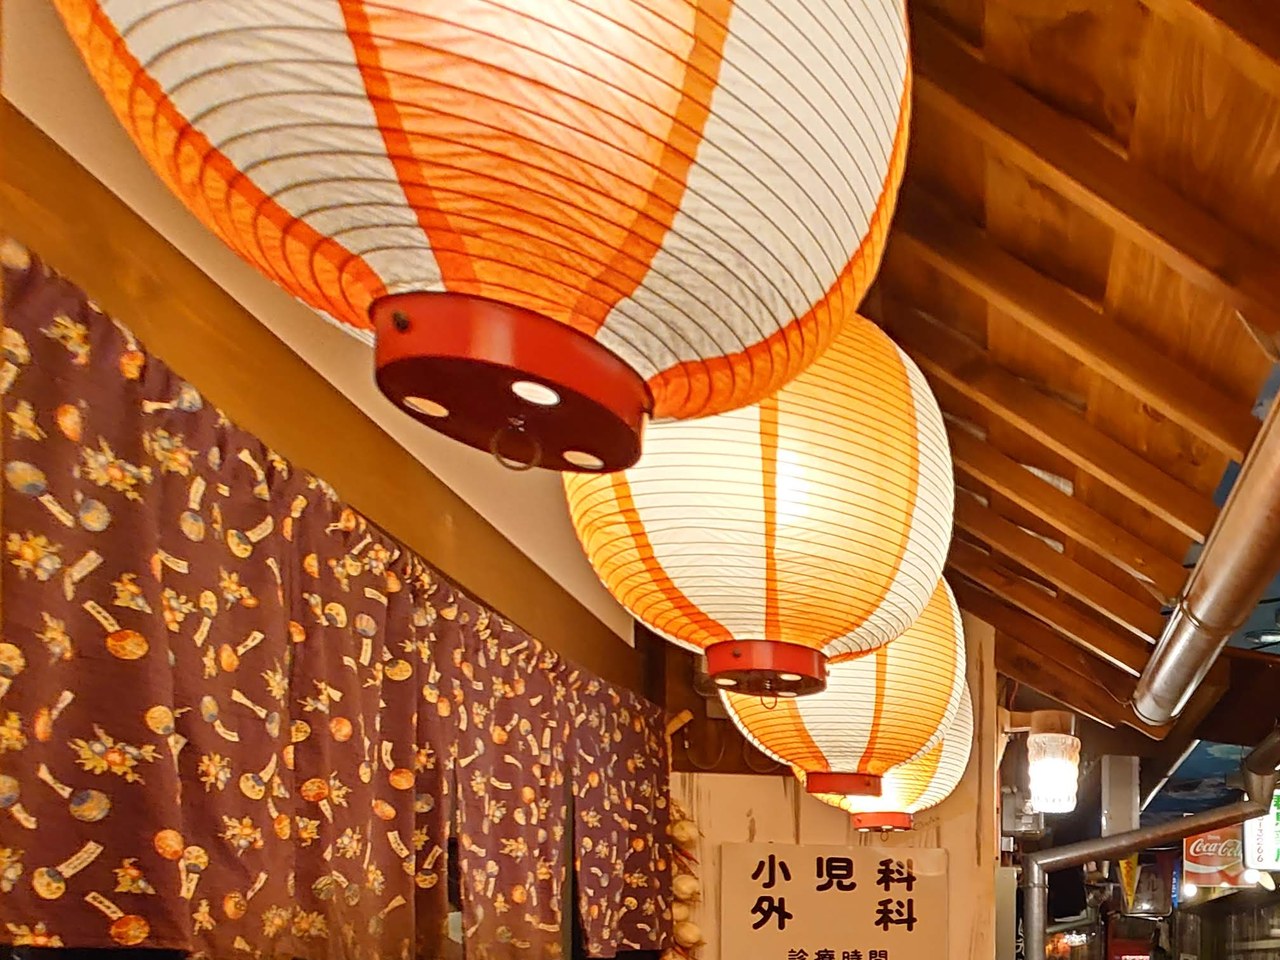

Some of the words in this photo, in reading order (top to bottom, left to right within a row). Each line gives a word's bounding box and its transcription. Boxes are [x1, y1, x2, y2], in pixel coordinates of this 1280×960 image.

[750, 854, 917, 892] 小児科
[750, 895, 918, 932] 外科
